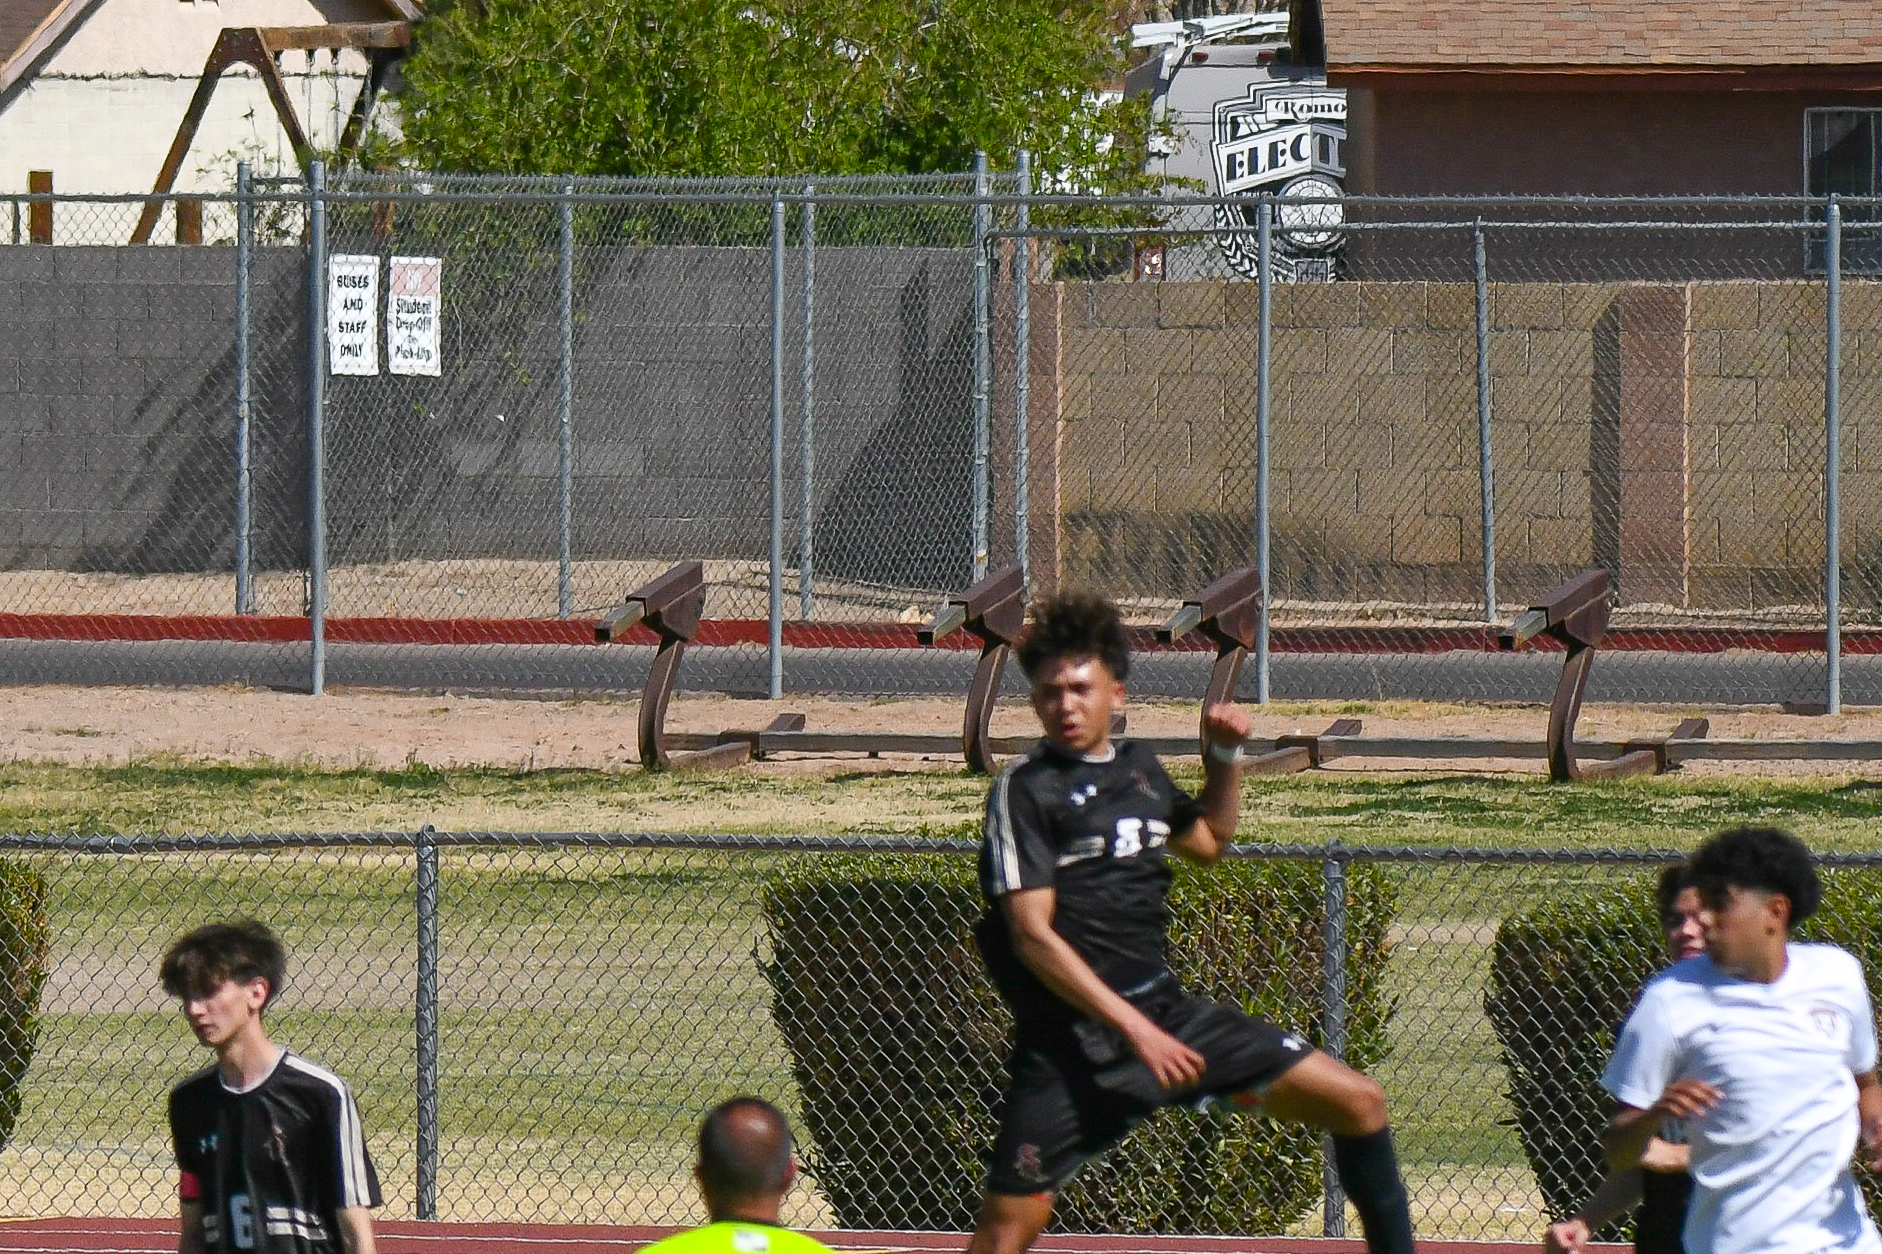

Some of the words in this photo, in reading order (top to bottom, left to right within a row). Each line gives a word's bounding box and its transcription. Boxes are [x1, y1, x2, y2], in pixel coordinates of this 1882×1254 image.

[1226, 133, 1347, 183] ELECT
[337, 275, 369, 288] BUSES
[343, 298, 363, 310] AND
[396, 298, 432, 314] Student
[339, 321, 366, 333] STAFF
[341, 344, 363, 357] ONLY
[230, 1194, 254, 1249] 6
